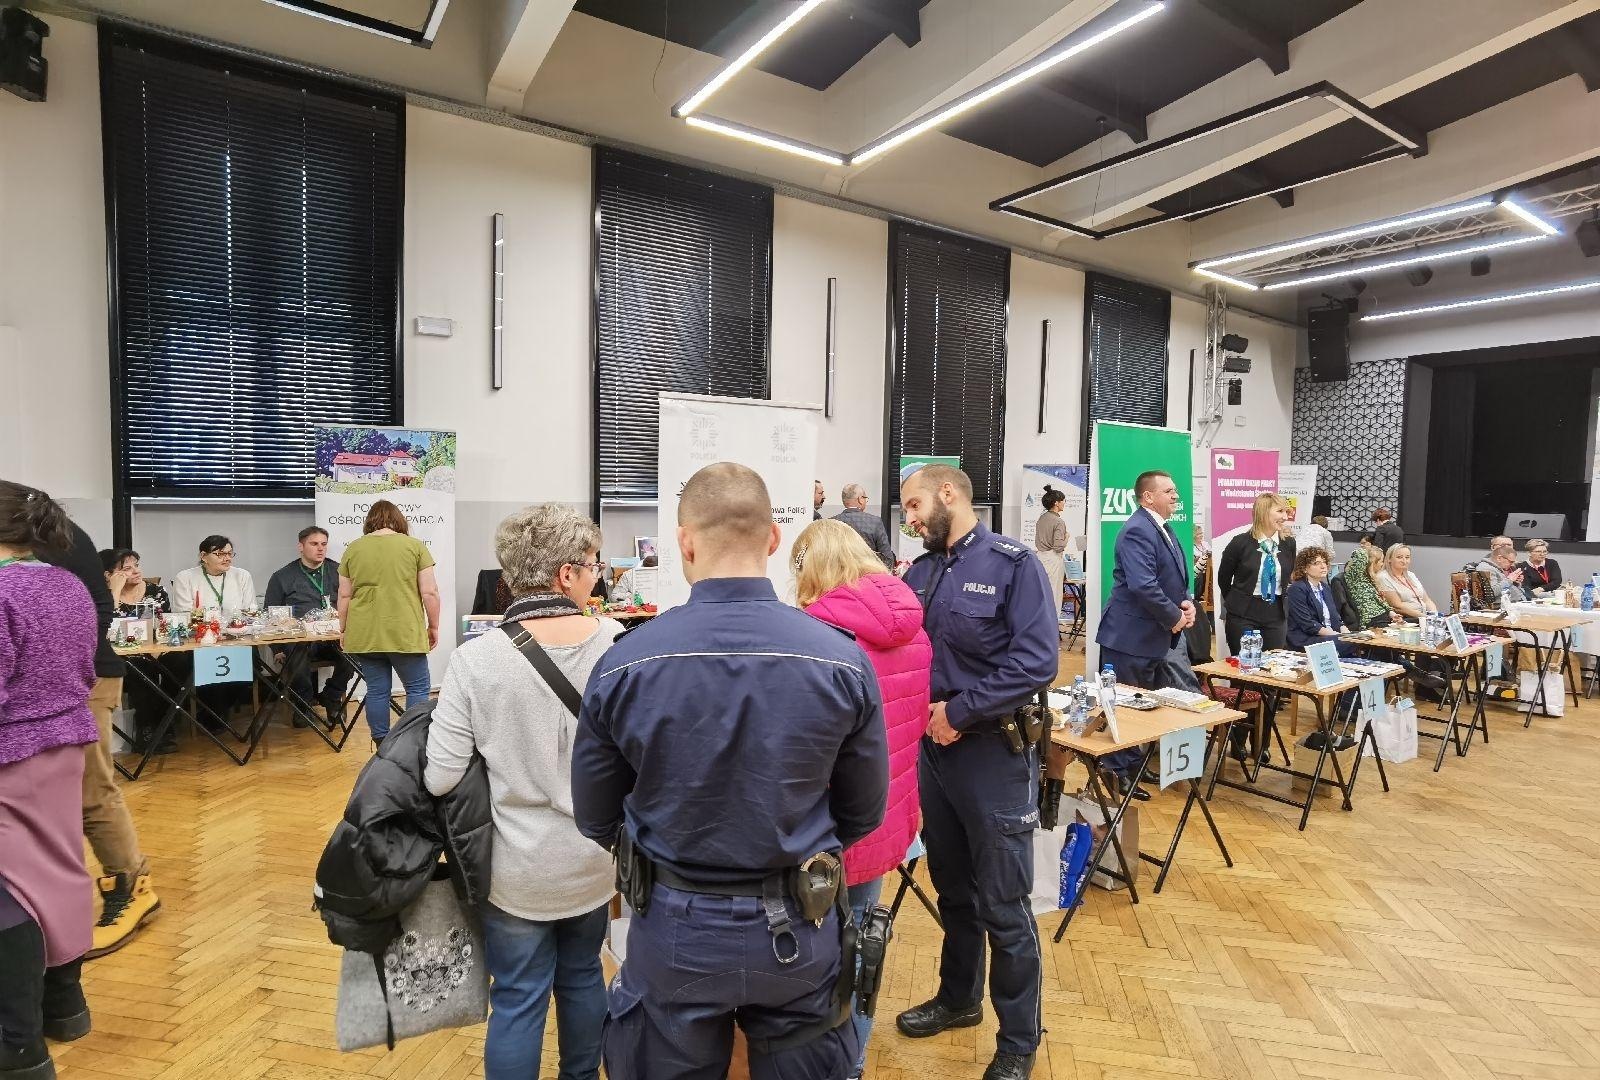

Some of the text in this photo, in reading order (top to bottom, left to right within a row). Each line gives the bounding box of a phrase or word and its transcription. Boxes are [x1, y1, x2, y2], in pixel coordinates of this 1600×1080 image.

[1102, 487, 1137, 515] ZUS
[962, 582, 996, 595] POLICJA
[215, 655, 231, 677] 3
[1166, 742, 1190, 777] 15
